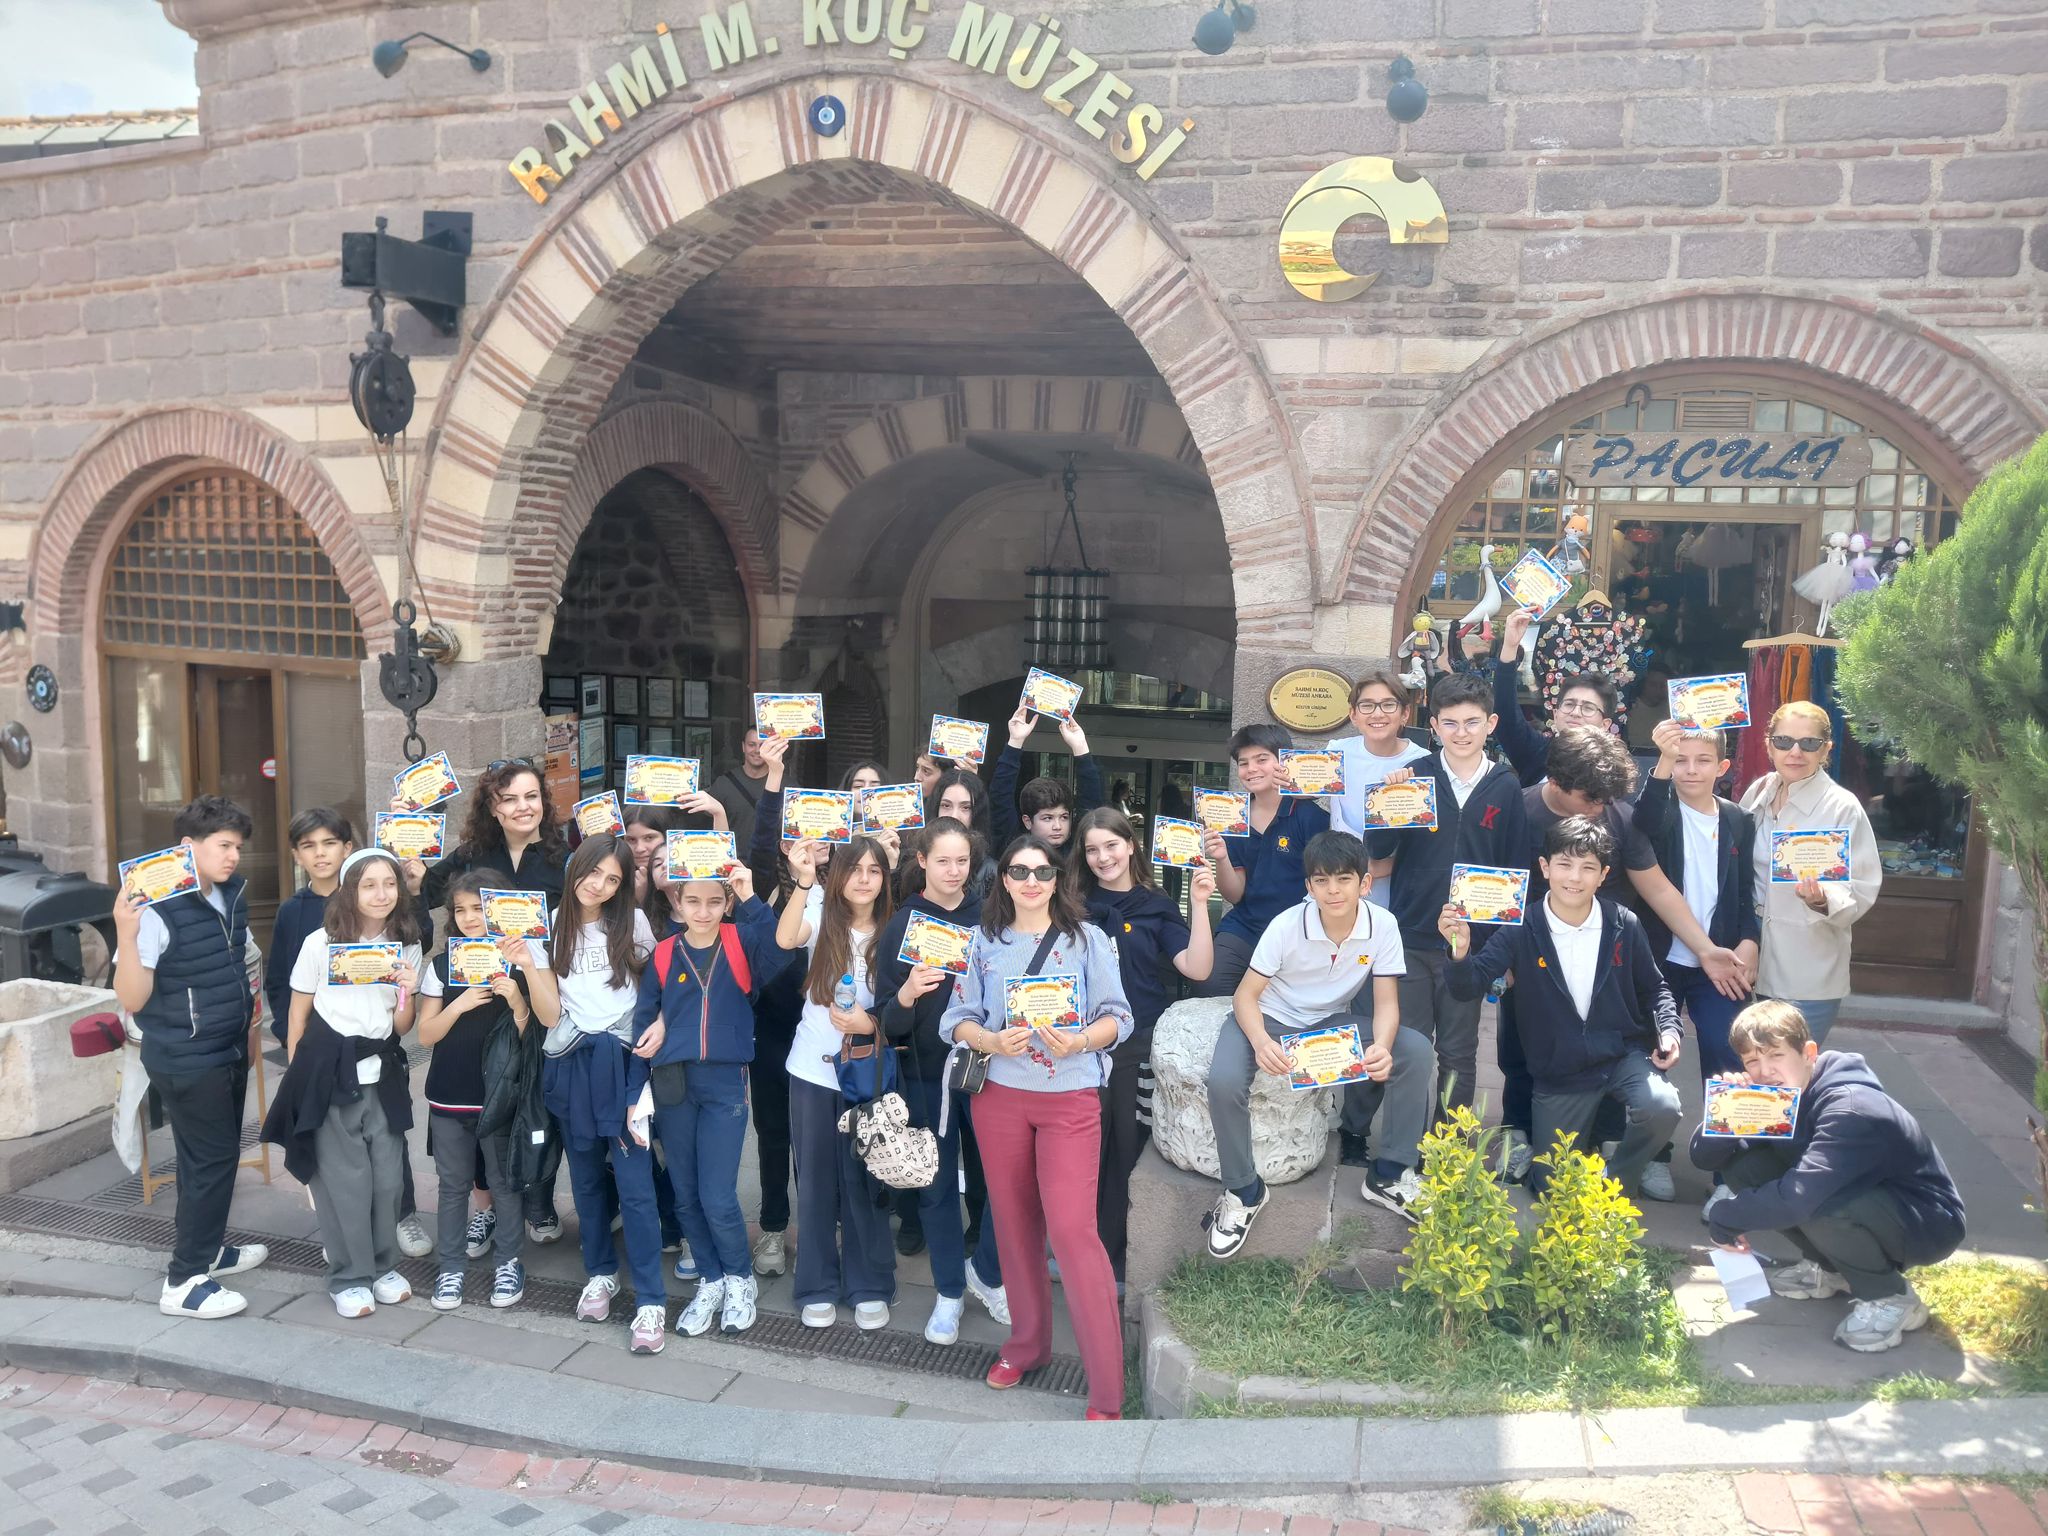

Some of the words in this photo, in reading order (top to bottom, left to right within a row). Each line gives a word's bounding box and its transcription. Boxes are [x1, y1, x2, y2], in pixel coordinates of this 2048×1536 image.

[508, 21, 688, 205] RAHMİ
[700, 0, 780, 71] M.
[803, 0, 930, 60] KOÇ
[947, 0, 1196, 182] MÜZESİ
